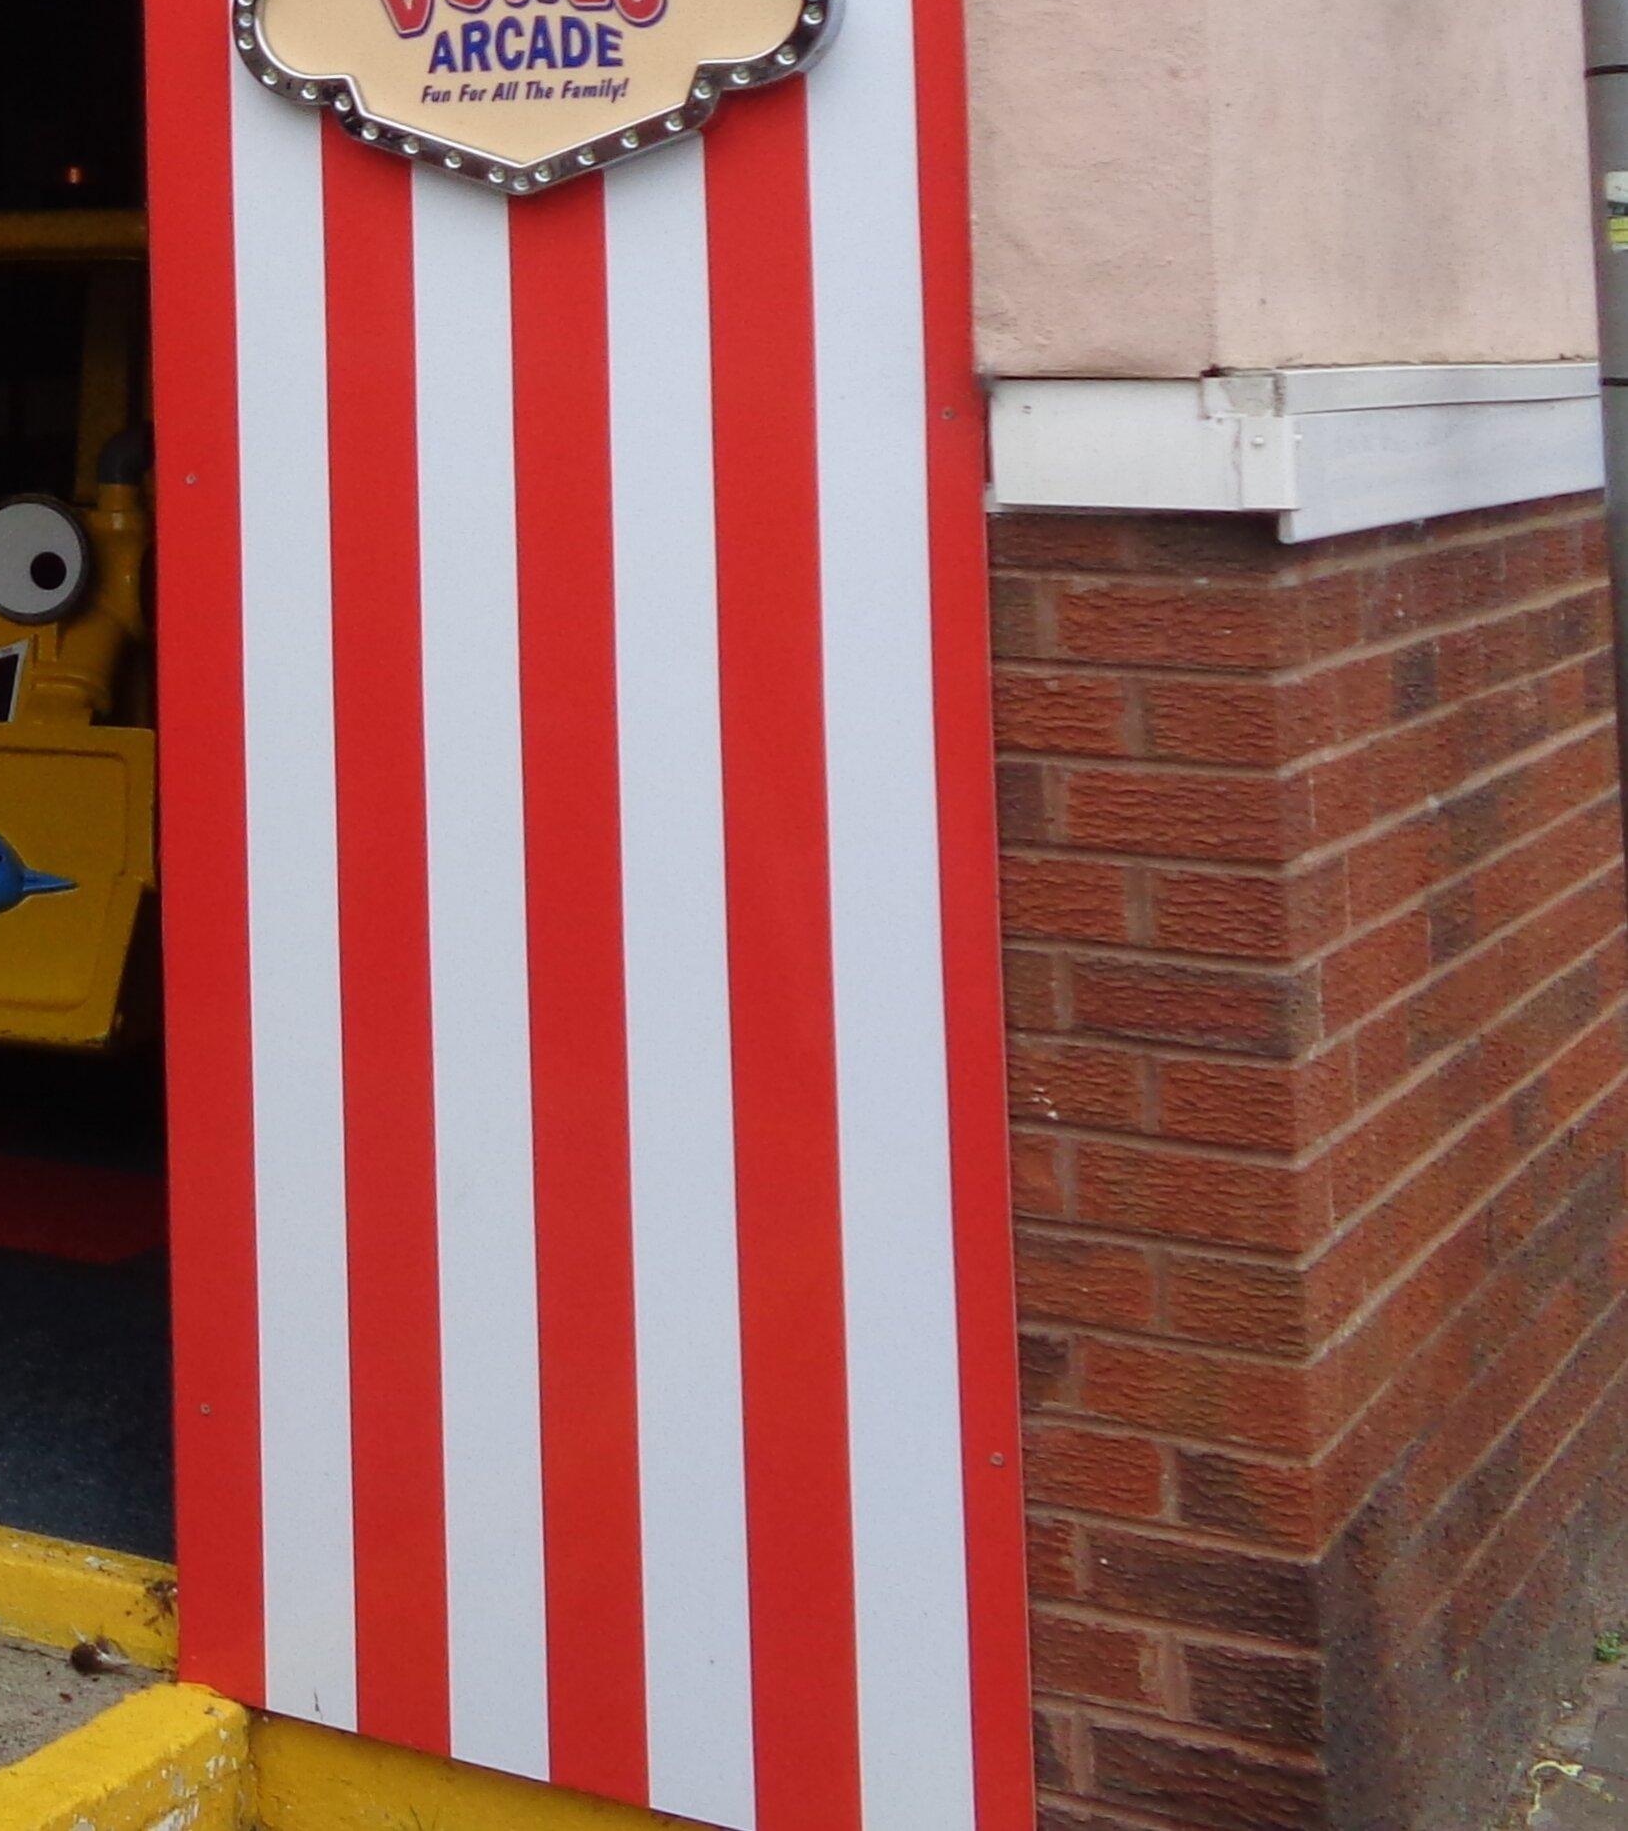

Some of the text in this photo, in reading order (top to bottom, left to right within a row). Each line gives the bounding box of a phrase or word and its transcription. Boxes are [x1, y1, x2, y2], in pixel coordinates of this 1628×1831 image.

[428, 15, 624, 74] ARCADE
[421, 78, 628, 103] Fun For All The Family!
